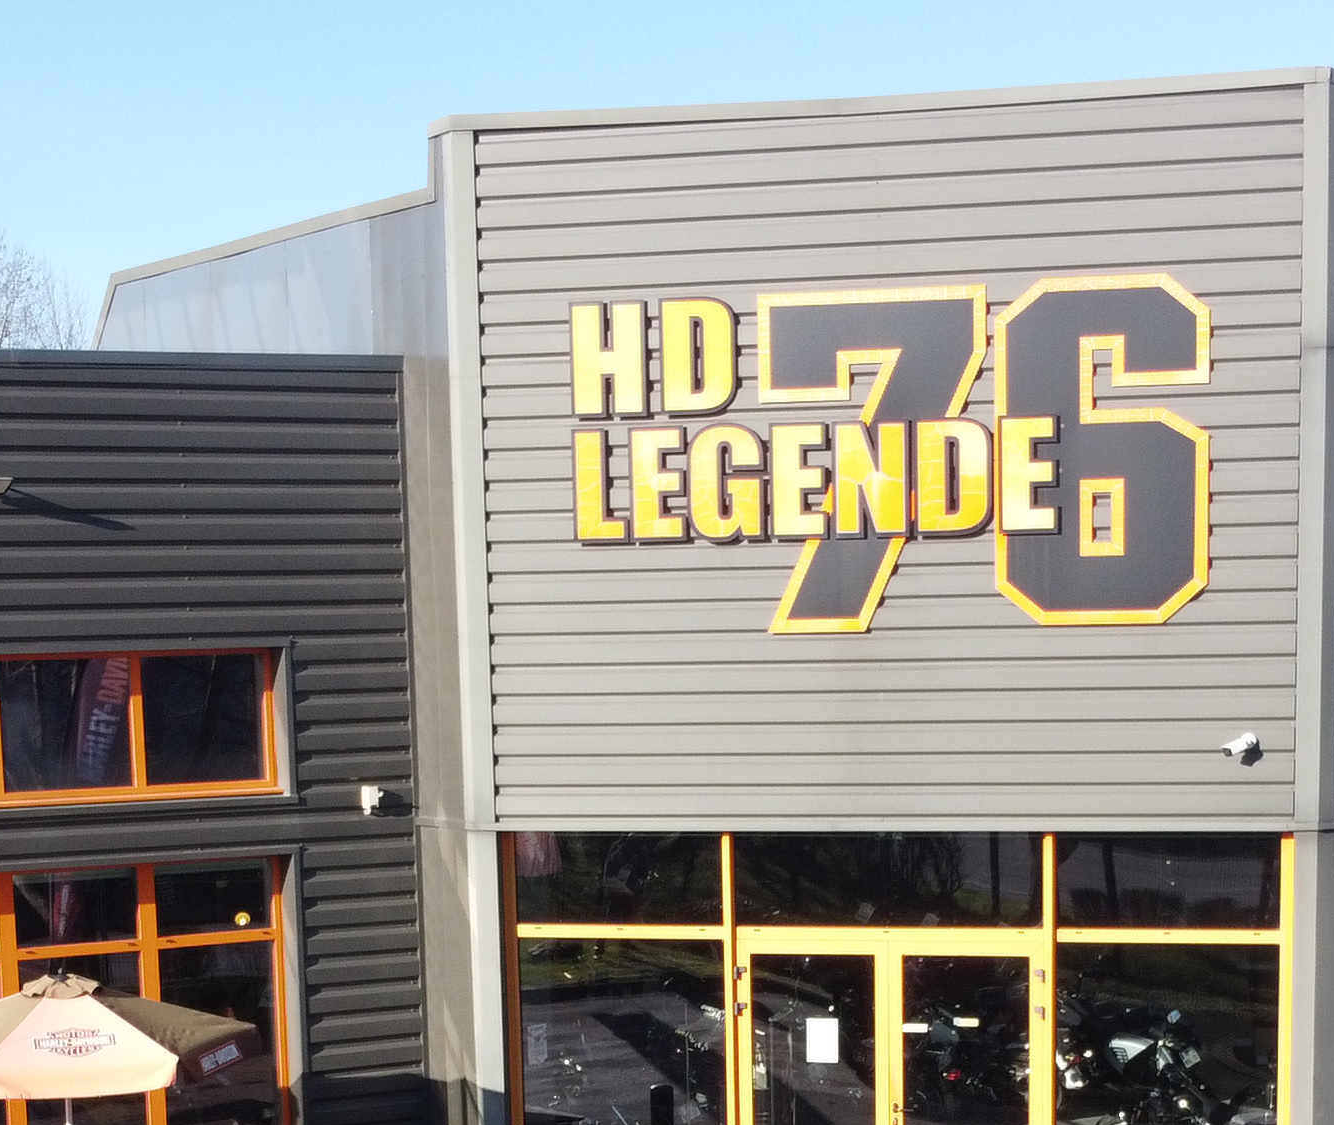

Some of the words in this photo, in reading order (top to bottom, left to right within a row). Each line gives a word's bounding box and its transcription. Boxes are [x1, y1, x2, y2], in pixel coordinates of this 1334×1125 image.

[568, 296, 739, 419] HD
[571, 414, 1061, 542] LEGENDE
[757, 273, 1211, 634] 76
